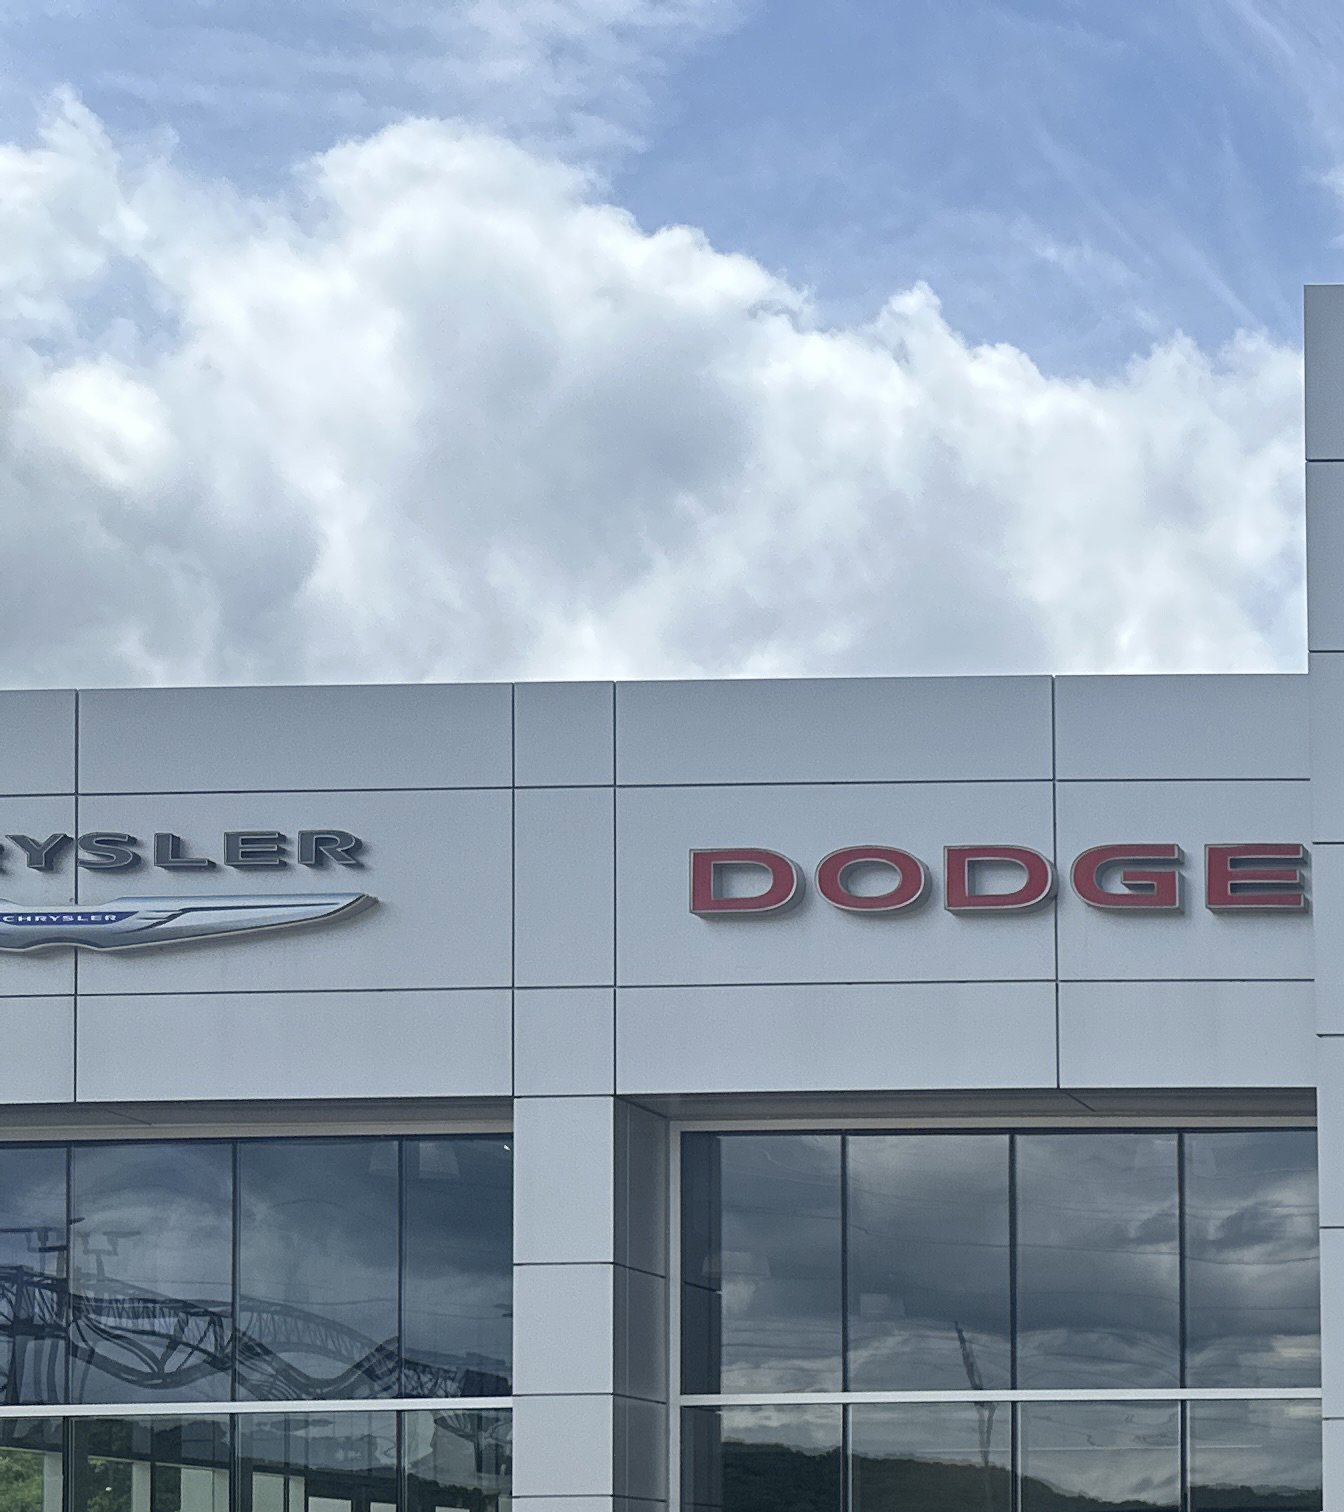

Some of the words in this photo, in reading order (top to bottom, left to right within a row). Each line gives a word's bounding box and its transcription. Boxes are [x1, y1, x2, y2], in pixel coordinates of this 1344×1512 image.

[0, 829, 362, 870] YSLER
[688, 843, 1312, 915] DODGE
[1, 913, 118, 923] CHRYSLER
